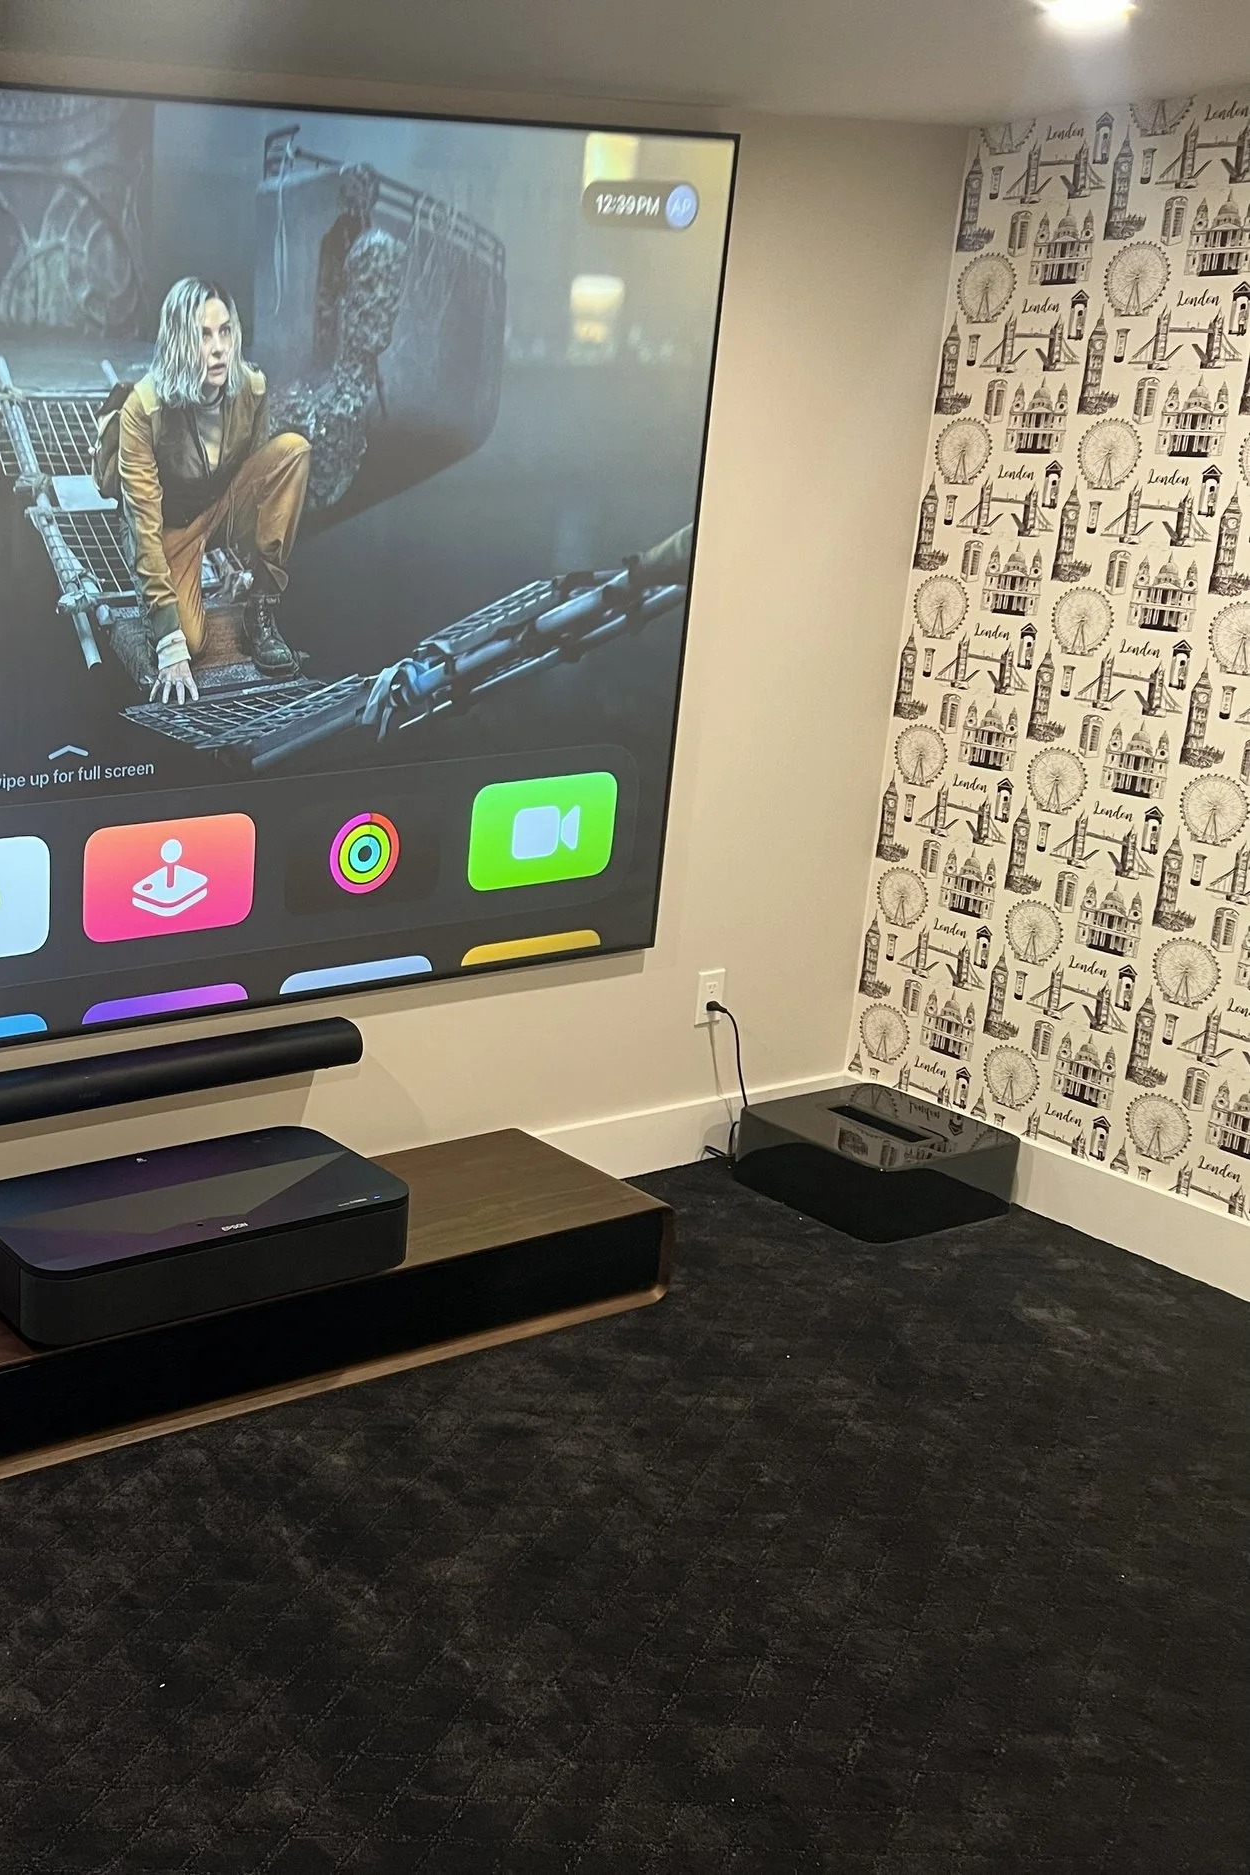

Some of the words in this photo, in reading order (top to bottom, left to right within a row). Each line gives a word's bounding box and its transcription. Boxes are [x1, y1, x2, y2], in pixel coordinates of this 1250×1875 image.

[1045, 121, 1085, 142] London
[636, 195, 661, 216] PM
[1021, 296, 1060, 314] London
[1176, 288, 1221, 308] London
[997, 464, 1035, 481] London
[1148, 468, 1190, 486] London
[973, 622, 1011, 641] London
[1119, 638, 1161, 659] London
[30, 773, 49, 788] up
[53, 769, 75, 784] for
[78, 765, 101, 782] full
[104, 763, 155, 779] screen
[952, 773, 988, 794] London
[1092, 800, 1133, 822] London
[933, 917, 967, 939] London
[1068, 954, 1107, 979] London
[1227, 997, 1250, 1018] Lon
[914, 1055, 947, 1079] London
[1044, 1102, 1083, 1128] London
[1197, 1155, 1241, 1183] London
